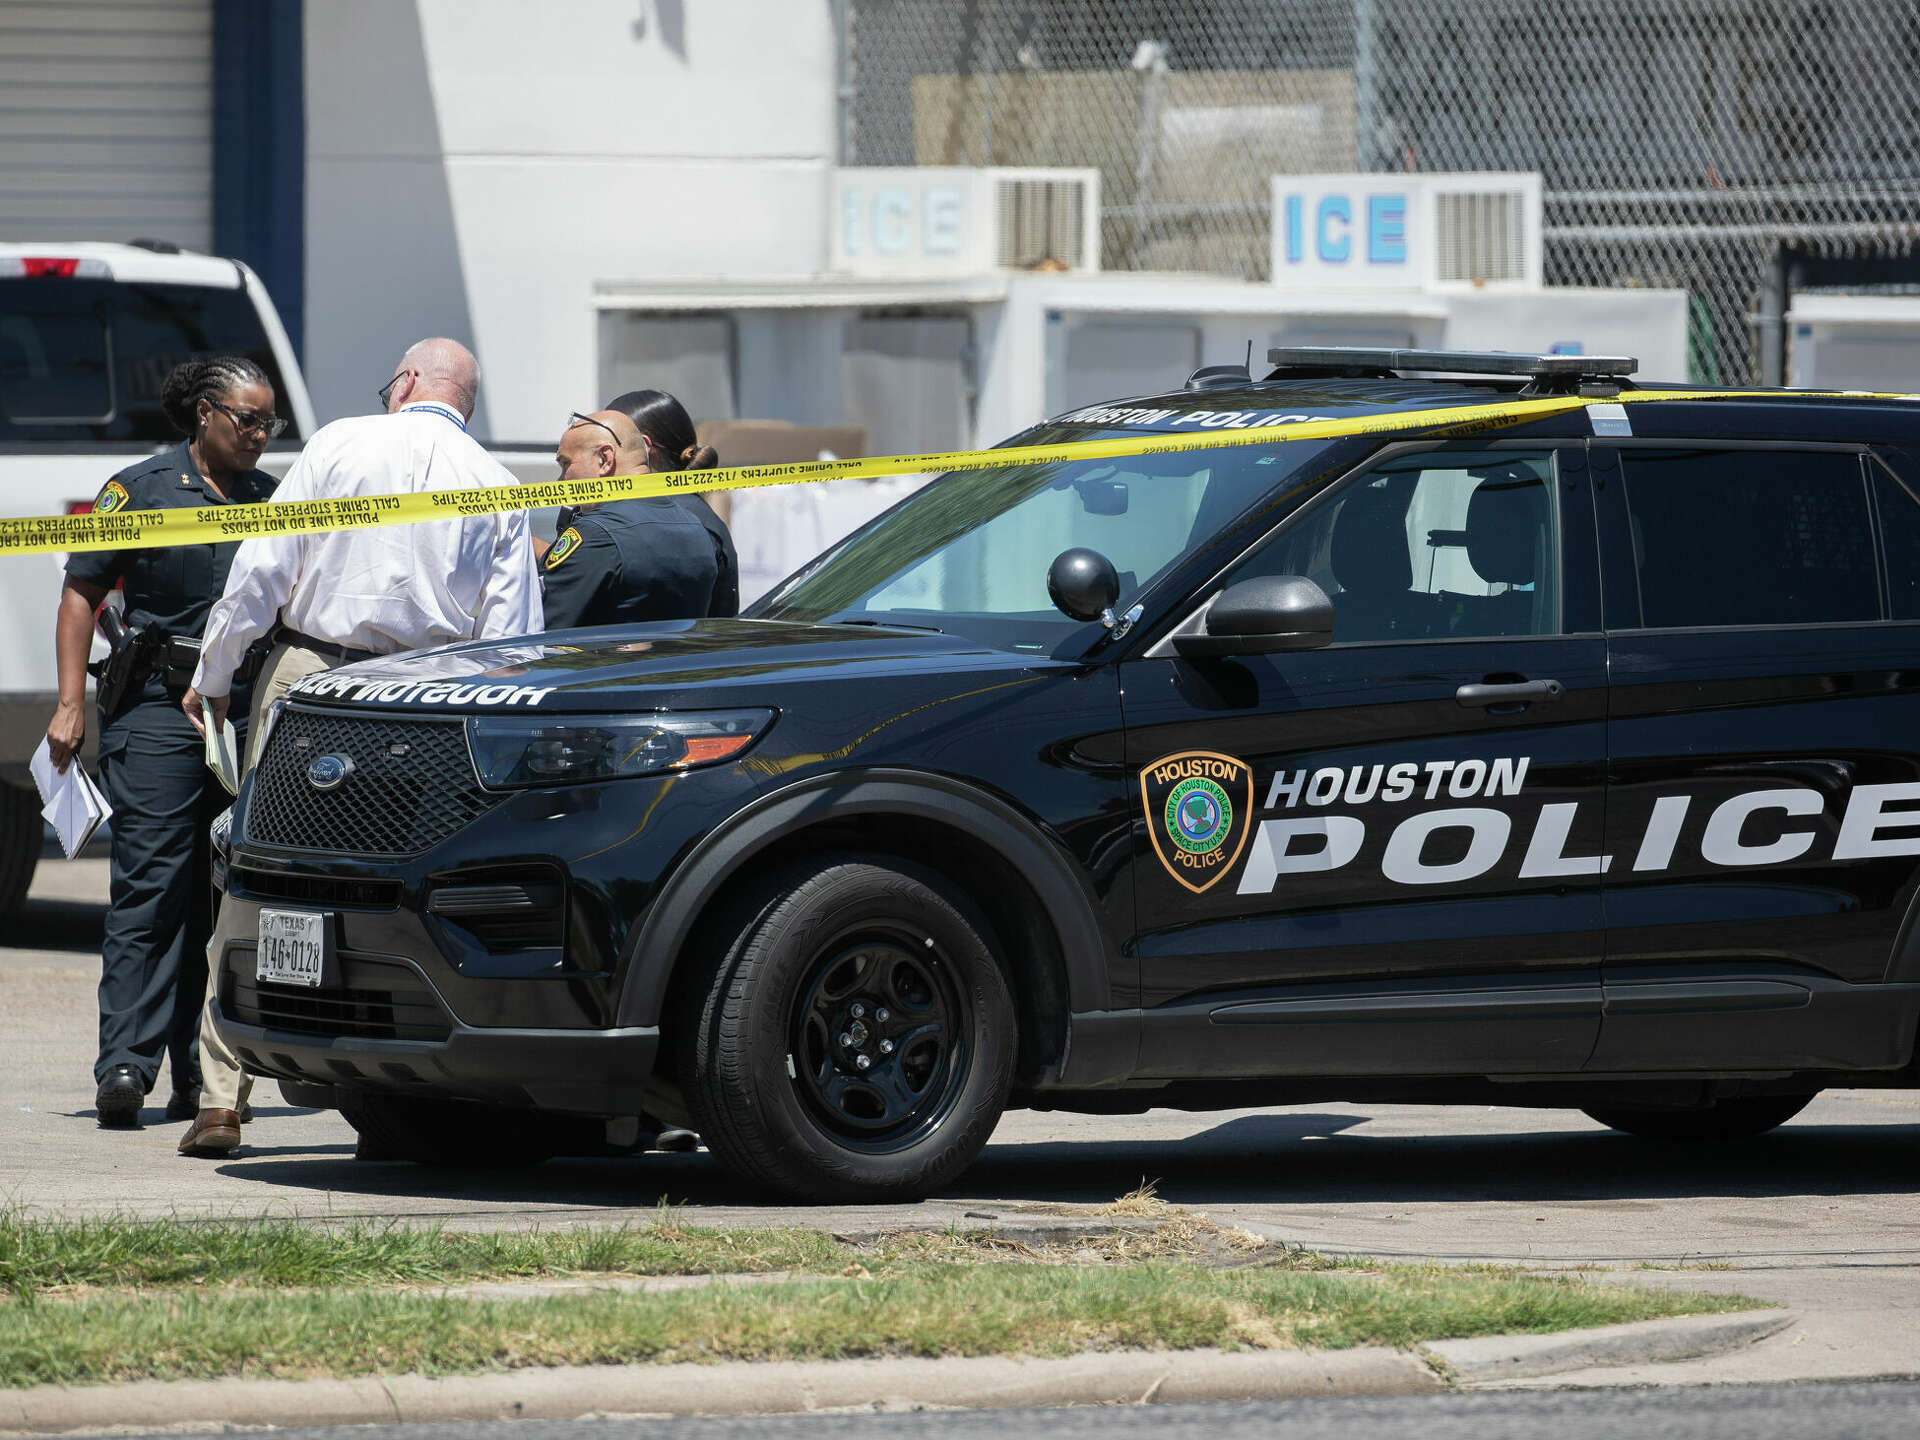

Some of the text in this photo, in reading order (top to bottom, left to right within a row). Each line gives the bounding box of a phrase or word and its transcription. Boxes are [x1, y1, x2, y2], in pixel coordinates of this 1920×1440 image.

[843, 186, 962, 257] ICE
[1286, 194, 1407, 264] ICE
[510, 485, 565, 499] STOPPERS
[570, 481, 604, 495] CRIME
[609, 478, 633, 491] CALL
[432, 487, 506, 506] 713-222-TIPS
[197, 496, 400, 523] CALL CRIME STOPPERS 713-222-TIPS
[37, 517, 95, 531] STOPPERS
[100, 515, 134, 529] CRIME
[140, 512, 164, 526] CALL
[221, 512, 379, 535] POLICE LINE DO NOT CROSS
[25, 534, 47, 548] NOT
[50, 533, 66, 545] DO
[71, 530, 96, 544] LINE
[100, 528, 141, 542] POLICE
[1154, 759, 1238, 785] HOUSTON
[1263, 756, 1531, 809] HOUSTON
[1167, 779, 1231, 819] CITY OF HOUSTON POLICE
[1171, 827, 1192, 849] SPACE
[1192, 840, 1211, 852] CITY
[1236, 782, 1920, 895] POLICE
[1173, 847, 1226, 869] POLICE
[280, 916, 305, 930] TEXAS
